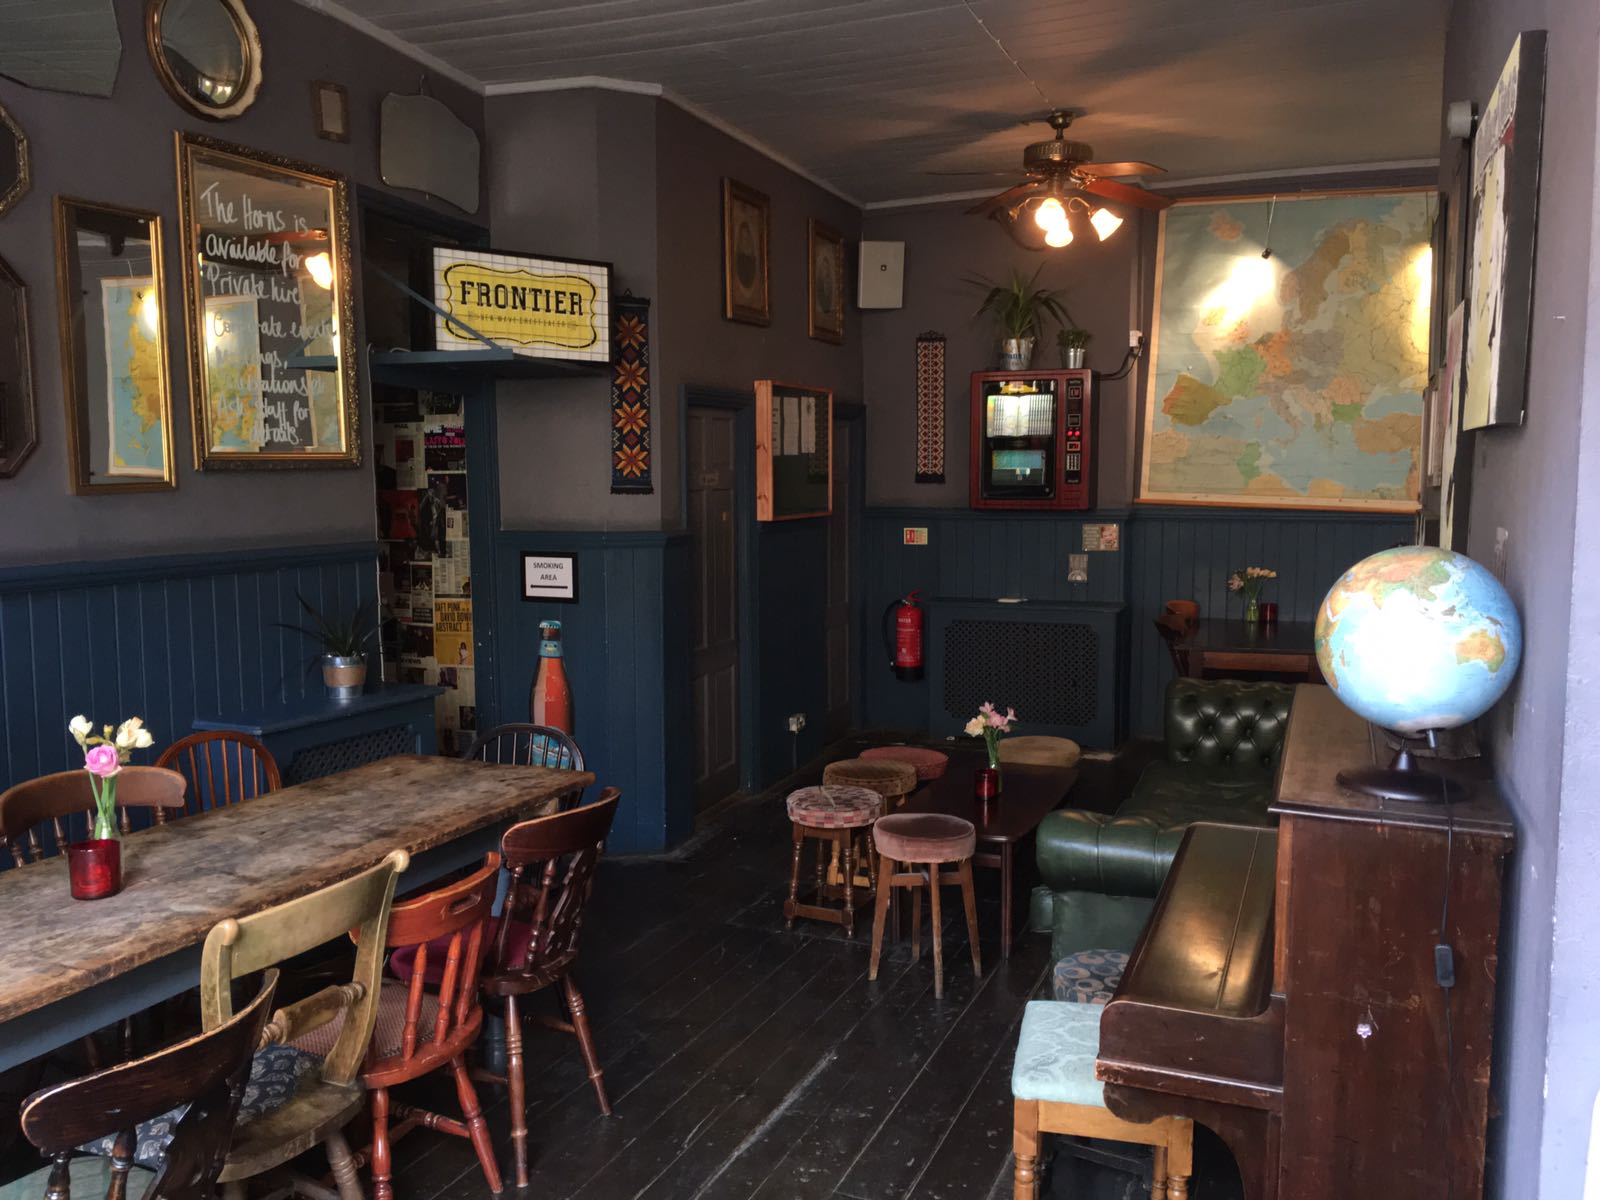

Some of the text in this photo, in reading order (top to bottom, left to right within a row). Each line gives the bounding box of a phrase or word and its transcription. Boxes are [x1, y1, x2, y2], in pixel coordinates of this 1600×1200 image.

[200, 182, 309, 236] The Horns is
[280, 240, 304, 277] for
[206, 263, 301, 305] Private hire
[460, 280, 584, 316] FRONTIER
[533, 562, 564, 570] SMOKING
[540, 573, 558, 581] AREA
